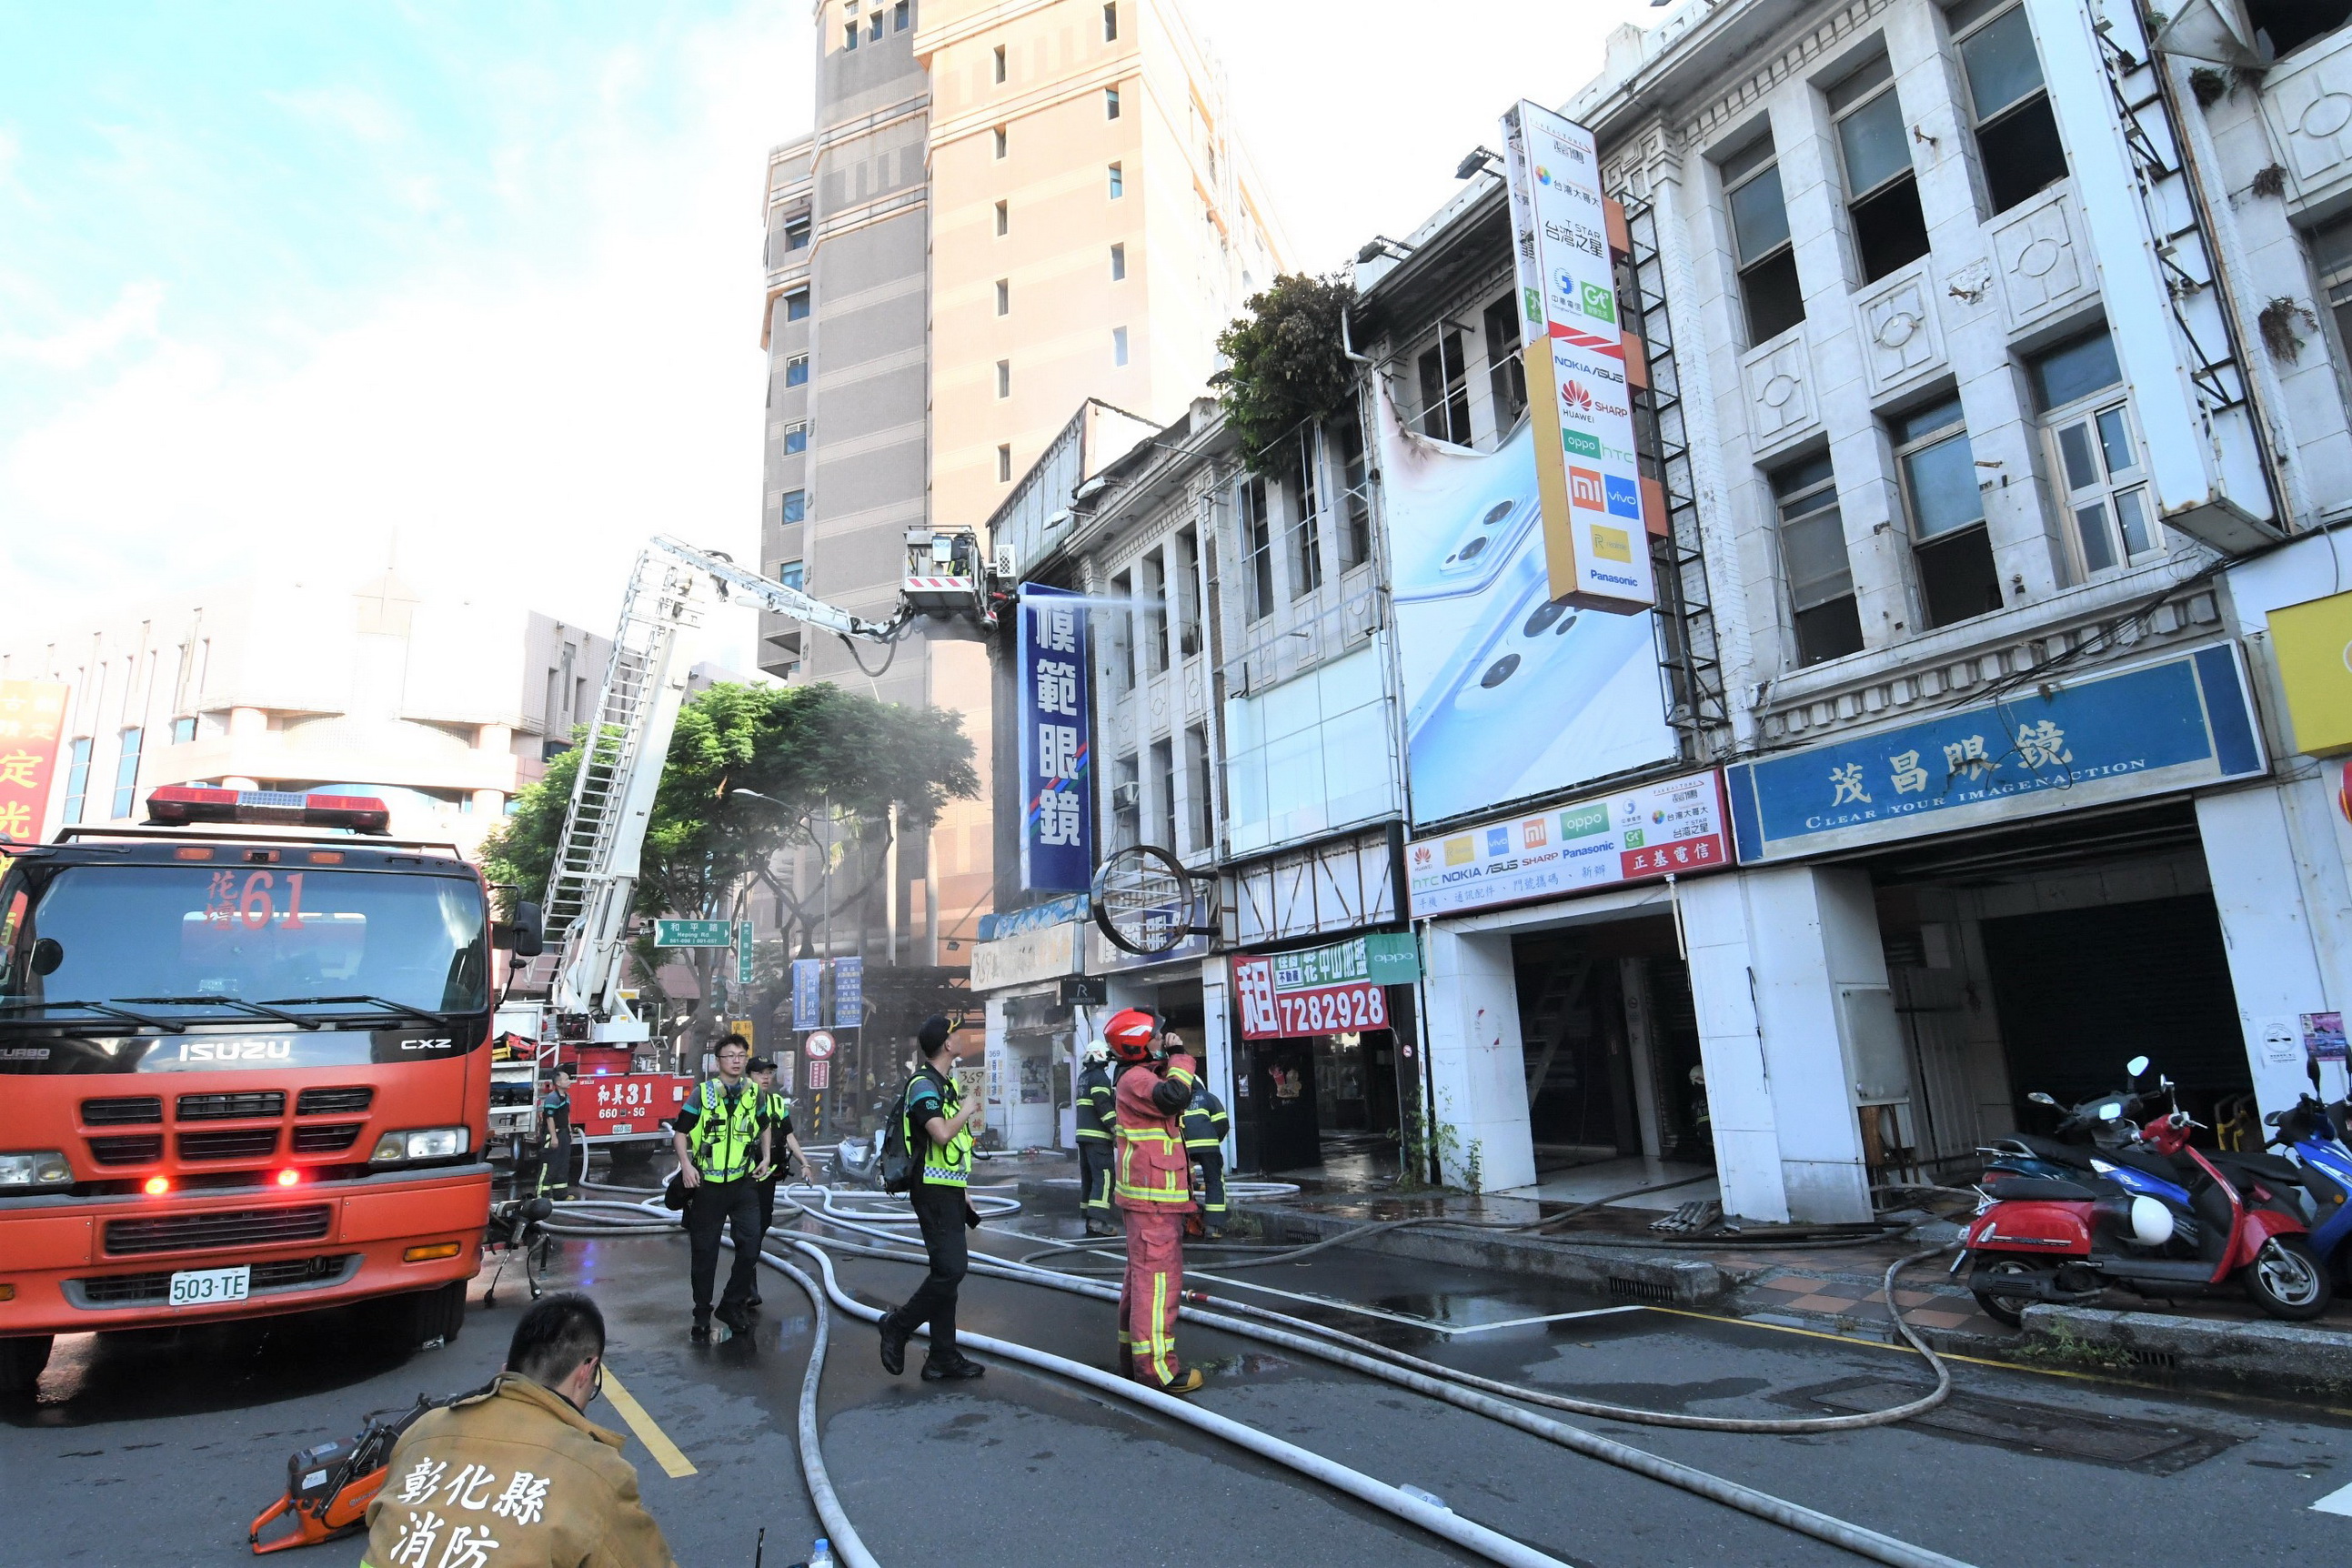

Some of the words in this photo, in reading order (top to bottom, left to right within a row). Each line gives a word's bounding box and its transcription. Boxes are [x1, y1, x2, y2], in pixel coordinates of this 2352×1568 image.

[1574, 224, 1601, 240] STAR
[1554, 356, 1592, 375] NOKIA
[1593, 367, 1624, 384] ASUS
[1563, 409, 1595, 424] HUAWEI
[1594, 401, 1628, 418] SHARP
[1608, 491, 1637, 506] vivo
[1590, 568, 1639, 588] Panasonic
[1036, 600, 1081, 847] 模範眼鏡
[1828, 719, 2074, 808] 茂昌眼鏡
[1889, 796, 1946, 815] YOUR
[1566, 813, 1603, 832] oppo
[1489, 838, 1508, 848] vivo
[1442, 867, 1483, 884] NOKIA
[1485, 859, 1519, 875] ASUS
[1522, 851, 1559, 867] SHARP
[1563, 840, 1614, 859] Panasonic
[1633, 842, 1710, 870] 正基電信
[240, 869, 306, 931] 61
[670, 922, 719, 932] 和平路
[1373, 952, 1414, 964] oppo
[1236, 960, 1279, 1034] 租
[1280, 987, 1384, 1032] 7282928
[179, 1040, 291, 1062] ISUZU
[401, 1038, 452, 1050] CXZ
[960, 1070, 984, 1084] 369
[173, 1274, 246, 1301] 503-TE
[397, 1457, 550, 1526] 彰化縣
[390, 1511, 500, 1568] 消防
